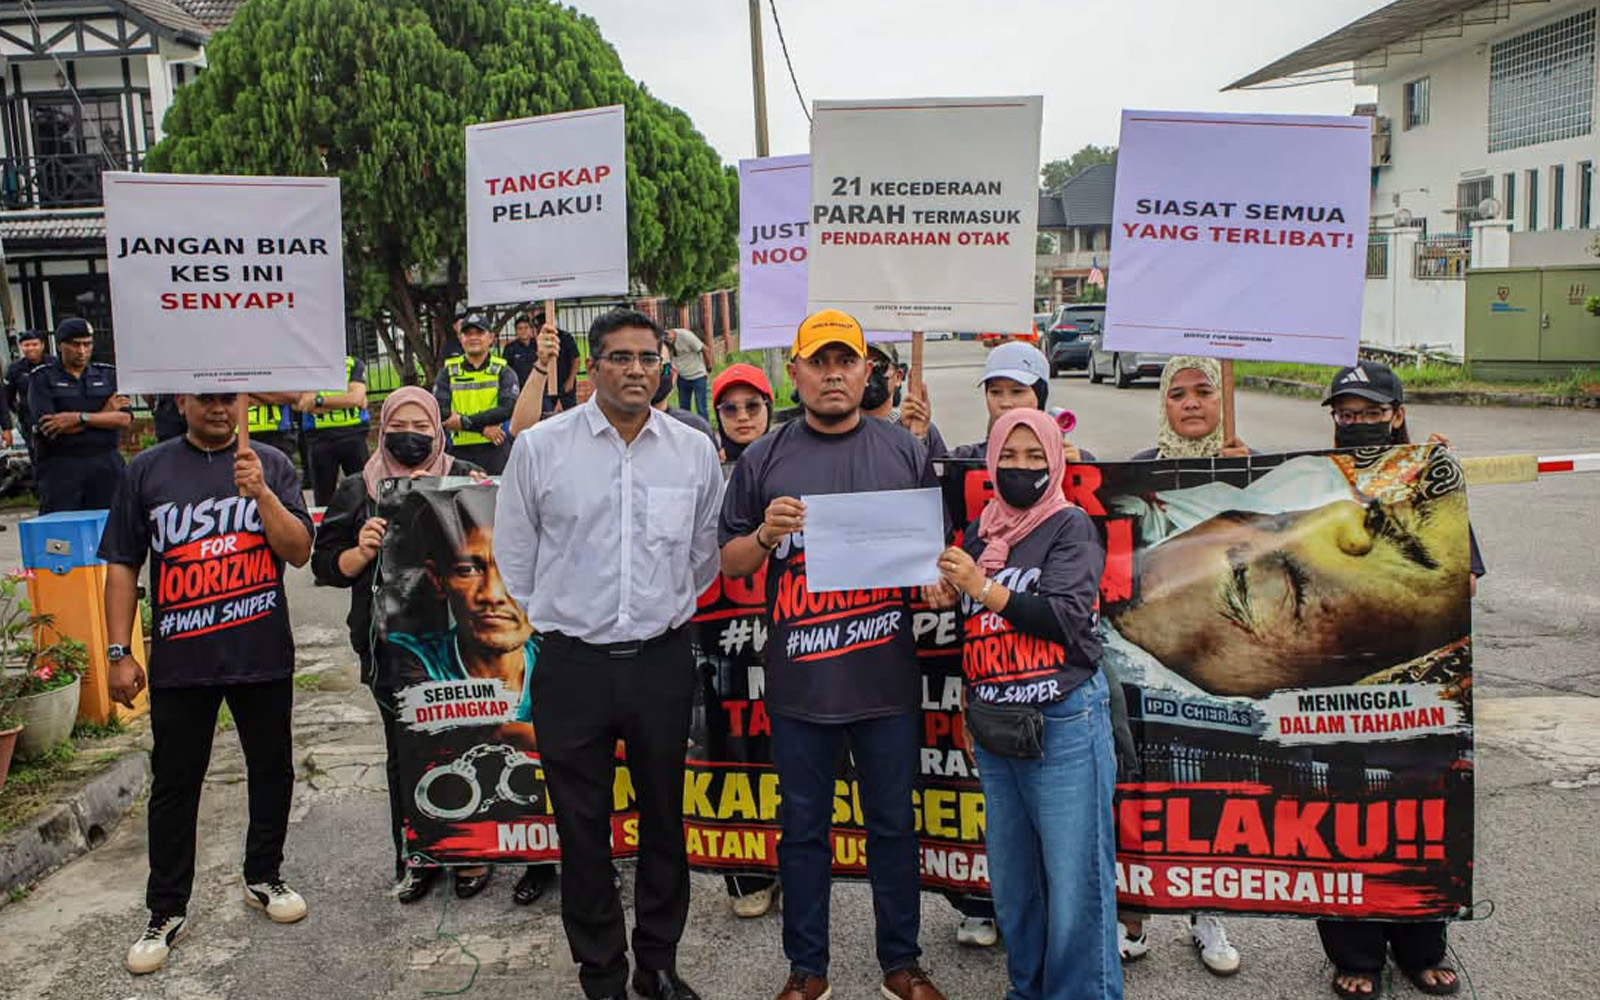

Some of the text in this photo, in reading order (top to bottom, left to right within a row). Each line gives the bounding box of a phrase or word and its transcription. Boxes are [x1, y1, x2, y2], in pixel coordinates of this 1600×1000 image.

[486, 165, 611, 196] TANGKAP
[832, 177, 1001, 196] 21 KECEDERAAN
[492, 194, 603, 223] PELAKU!
[813, 205, 1021, 225] PARAH TERMASUK
[1136, 198, 1346, 224] SIASAT SEMUA
[749, 220, 810, 245] JUST
[821, 231, 1010, 246] PENDARAHAN OTAK
[1122, 222, 1354, 249] YANG TERLIBAT!
[117, 237, 328, 258] JANGAN BIAR
[752, 246, 807, 266] NOO
[171, 265, 283, 282] KES INI
[160, 291, 295, 310] SENYAP!
[150, 496, 264, 553] JUSTIC
[201, 535, 238, 559] FOR
[158, 548, 277, 605] OORIZWA
[159, 590, 277, 638] #WAN SNIPER
[786, 610, 902, 657] #WAN SNIPER
[423, 684, 496, 704] SEBELUM
[1298, 690, 1413, 713] MENINGGAL
[415, 700, 509, 724] DITANGKAP
[1146, 701, 1176, 715] IPD
[1279, 706, 1445, 735] DALAM TAHANAN
[1114, 797, 1446, 861] ELAKU!!
[1115, 862, 1154, 897] AR
[1166, 868, 1364, 905] SEGERA!!!
